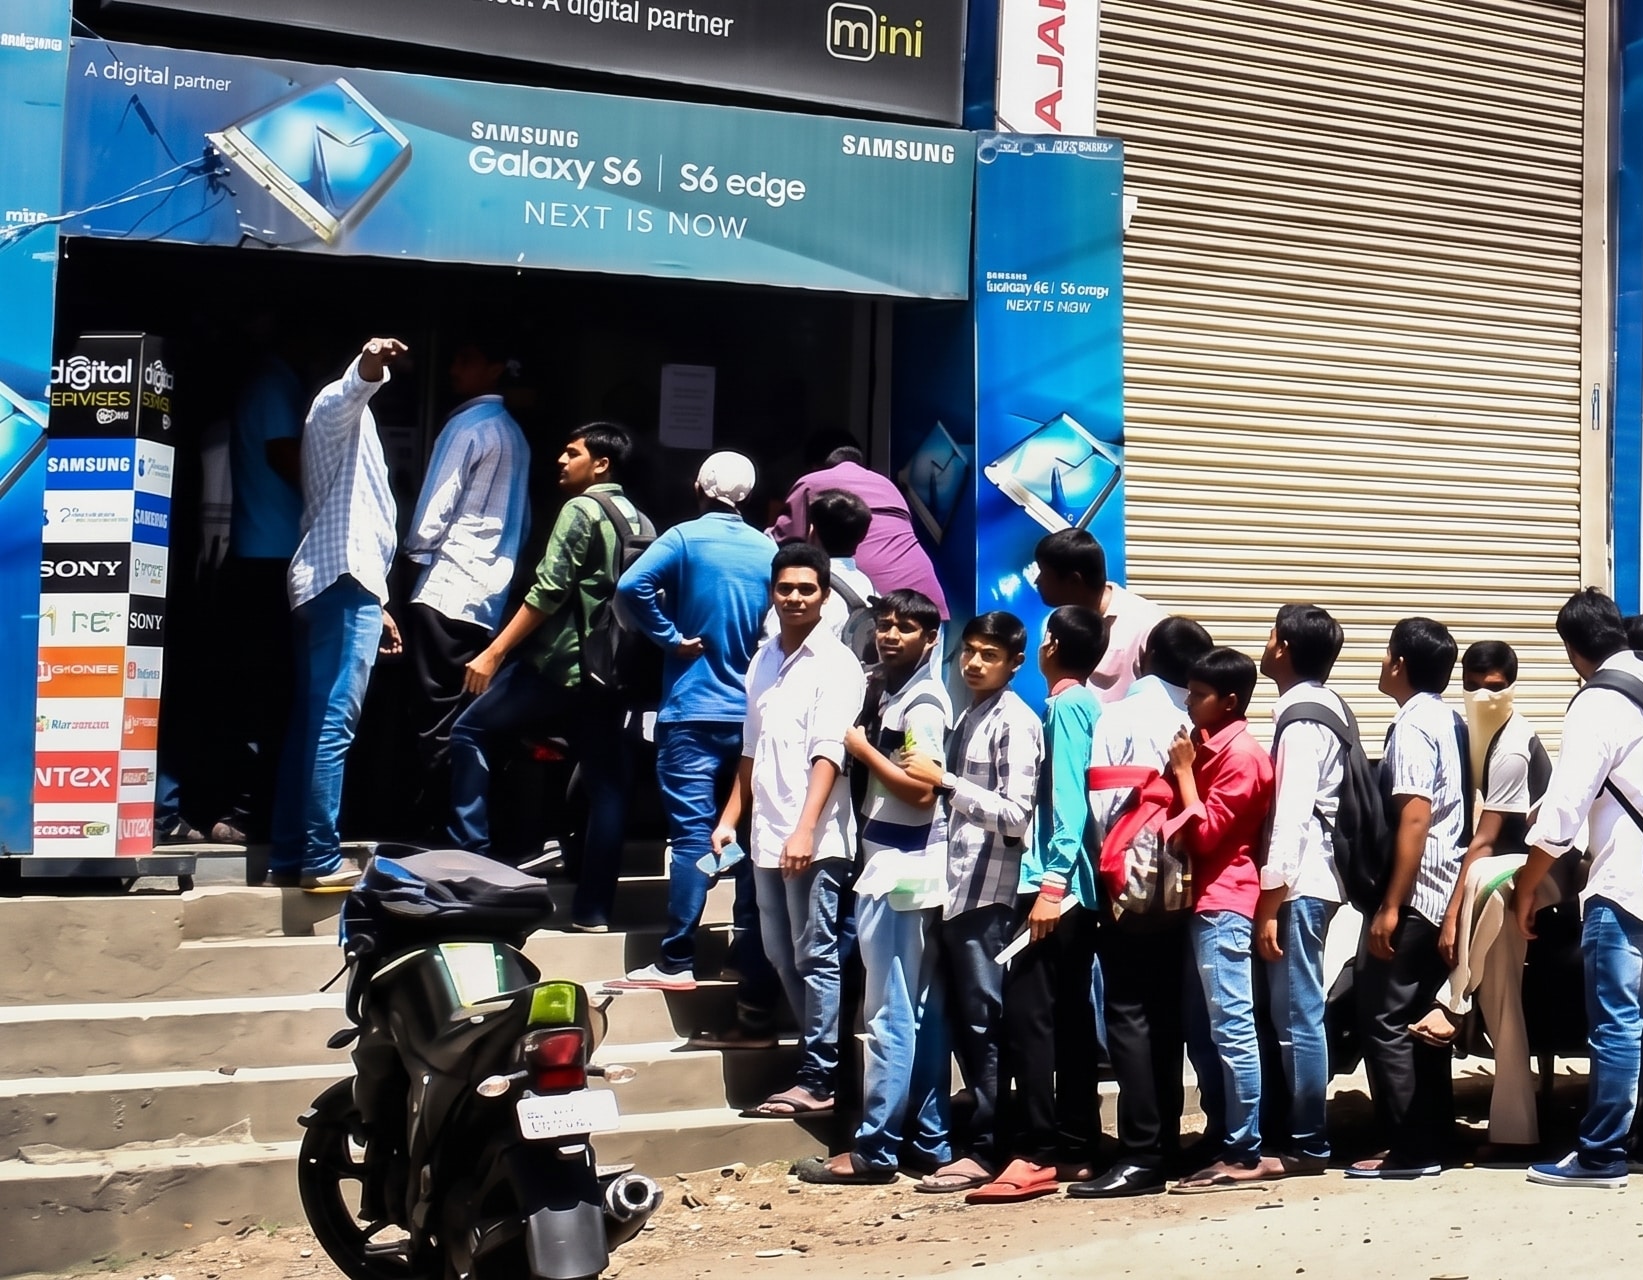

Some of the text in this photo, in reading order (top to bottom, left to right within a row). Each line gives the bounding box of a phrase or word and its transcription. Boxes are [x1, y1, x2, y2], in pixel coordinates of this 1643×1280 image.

[567, 0, 638, 25] digital
[648, 13, 733, 37] partner
[833, 14, 923, 59] mini
[84, 62, 232, 92] A digital partner
[471, 121, 579, 148] SAMSUNG
[842, 134, 955, 165] SAMSUNG
[469, 145, 806, 208] Galaxy S6 S6 edge
[524, 200, 748, 240] NEXT IS NOW
[1006, 299, 1041, 312] NEXT
[50, 357, 132, 391] digital
[47, 457, 130, 472] SAMSUNG
[40, 560, 122, 577] SONY
[129, 612, 163, 630] SONY
